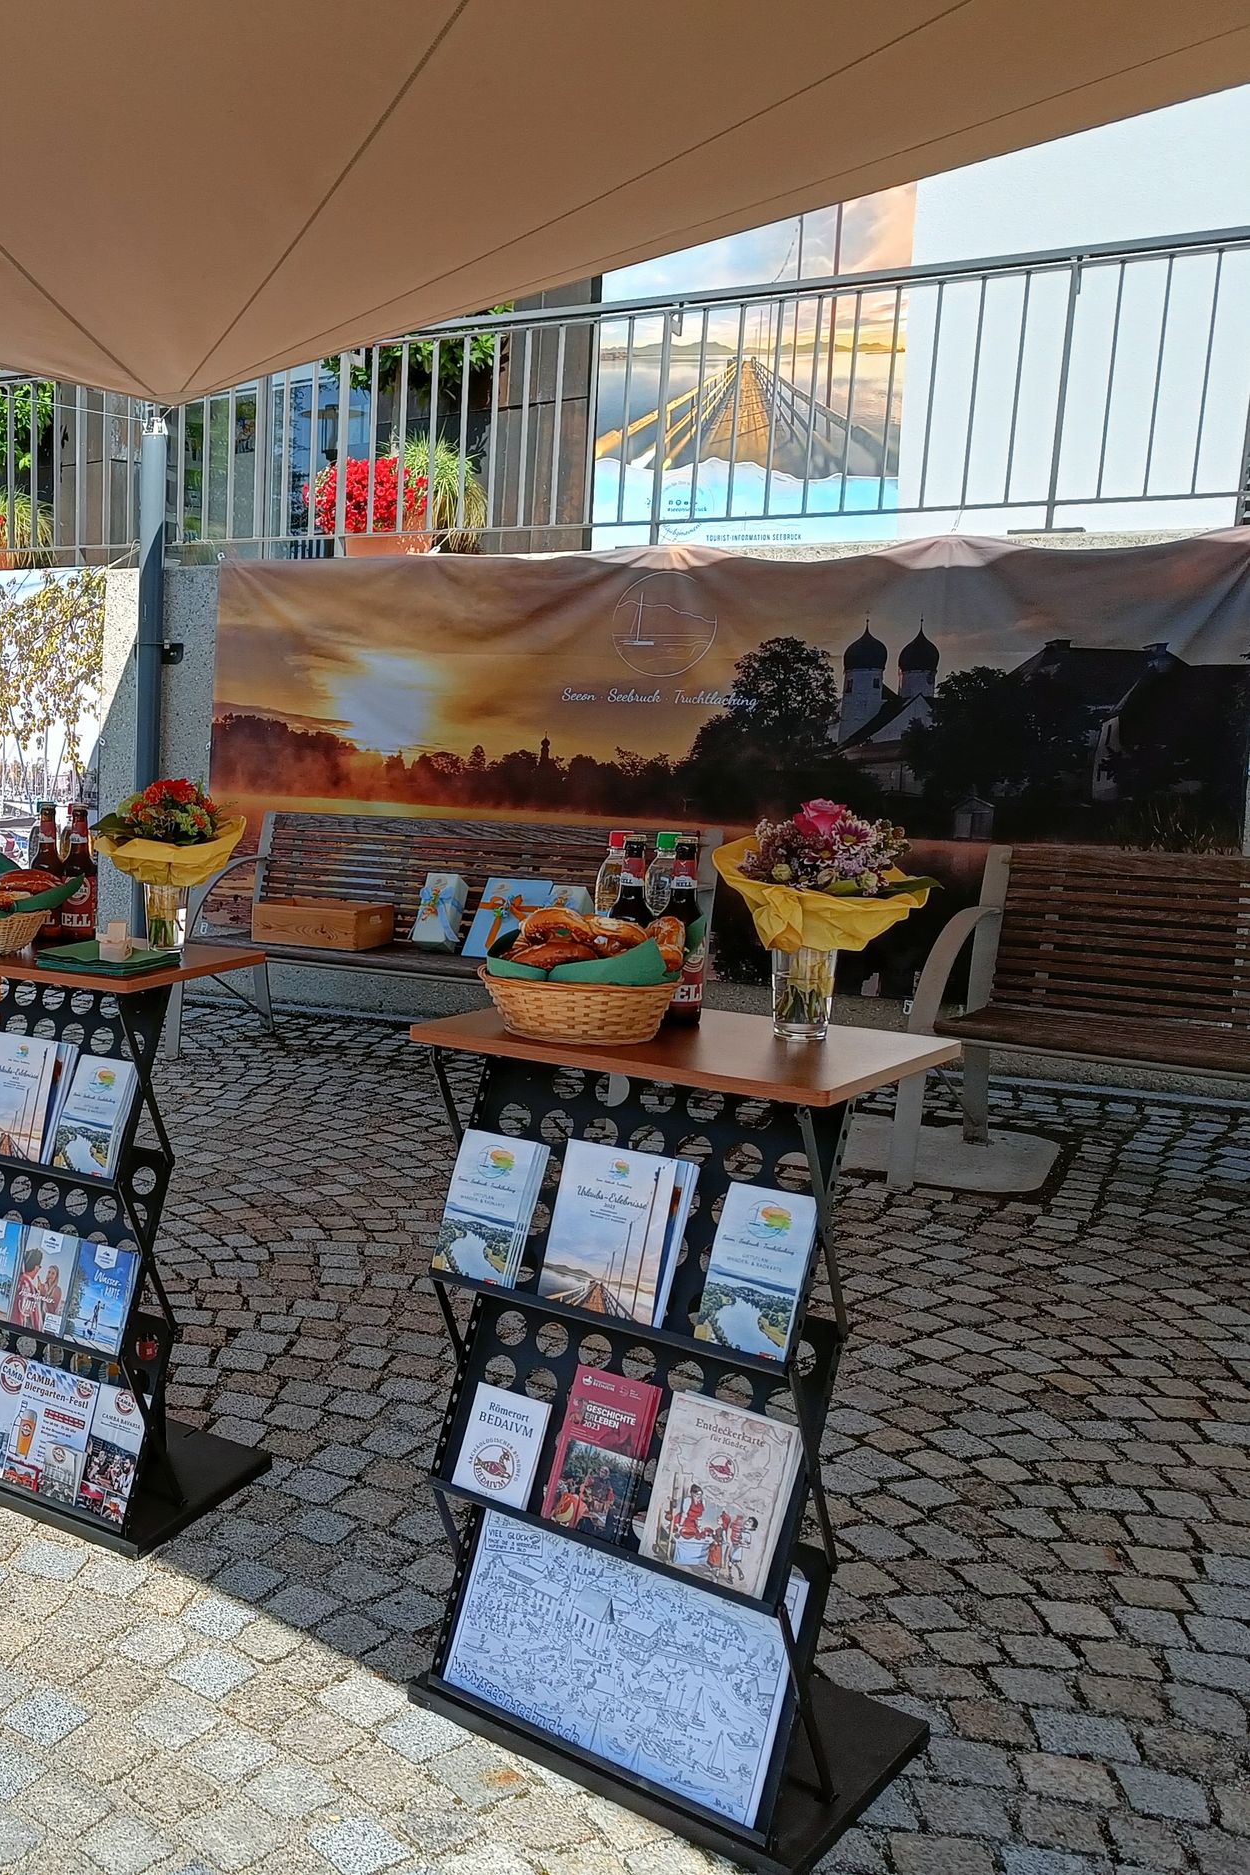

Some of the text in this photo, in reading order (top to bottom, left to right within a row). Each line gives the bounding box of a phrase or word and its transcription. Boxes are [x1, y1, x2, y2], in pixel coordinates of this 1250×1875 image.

[772, 533, 802, 541] SEEBRUCK
[561, 687, 759, 710] Seeon Seebruck Truchtlaching
[577, 1185, 648, 1210] Urlaubs-Erlebnisse
[26, 1371, 56, 1388] CAMBA
[24, 1381, 89, 1409] Biergarten-Festl
[117, 1396, 134, 1409] CAMBA
[488, 1401, 529, 1423] Römerort
[584, 1412, 620, 1430] ERLEBEN
[586, 1404, 637, 1426] GESCHICHTE
[478, 1410, 534, 1438] BEDAIVM
[582, 1419, 601, 1432] 2023
[695, 1417, 766, 1448] Entdeckerkarte
[710, 1433, 748, 1451] für Kinder
[475, 1466, 506, 1489] BEDAIVM
[488, 1529, 503, 1539] VIEL
